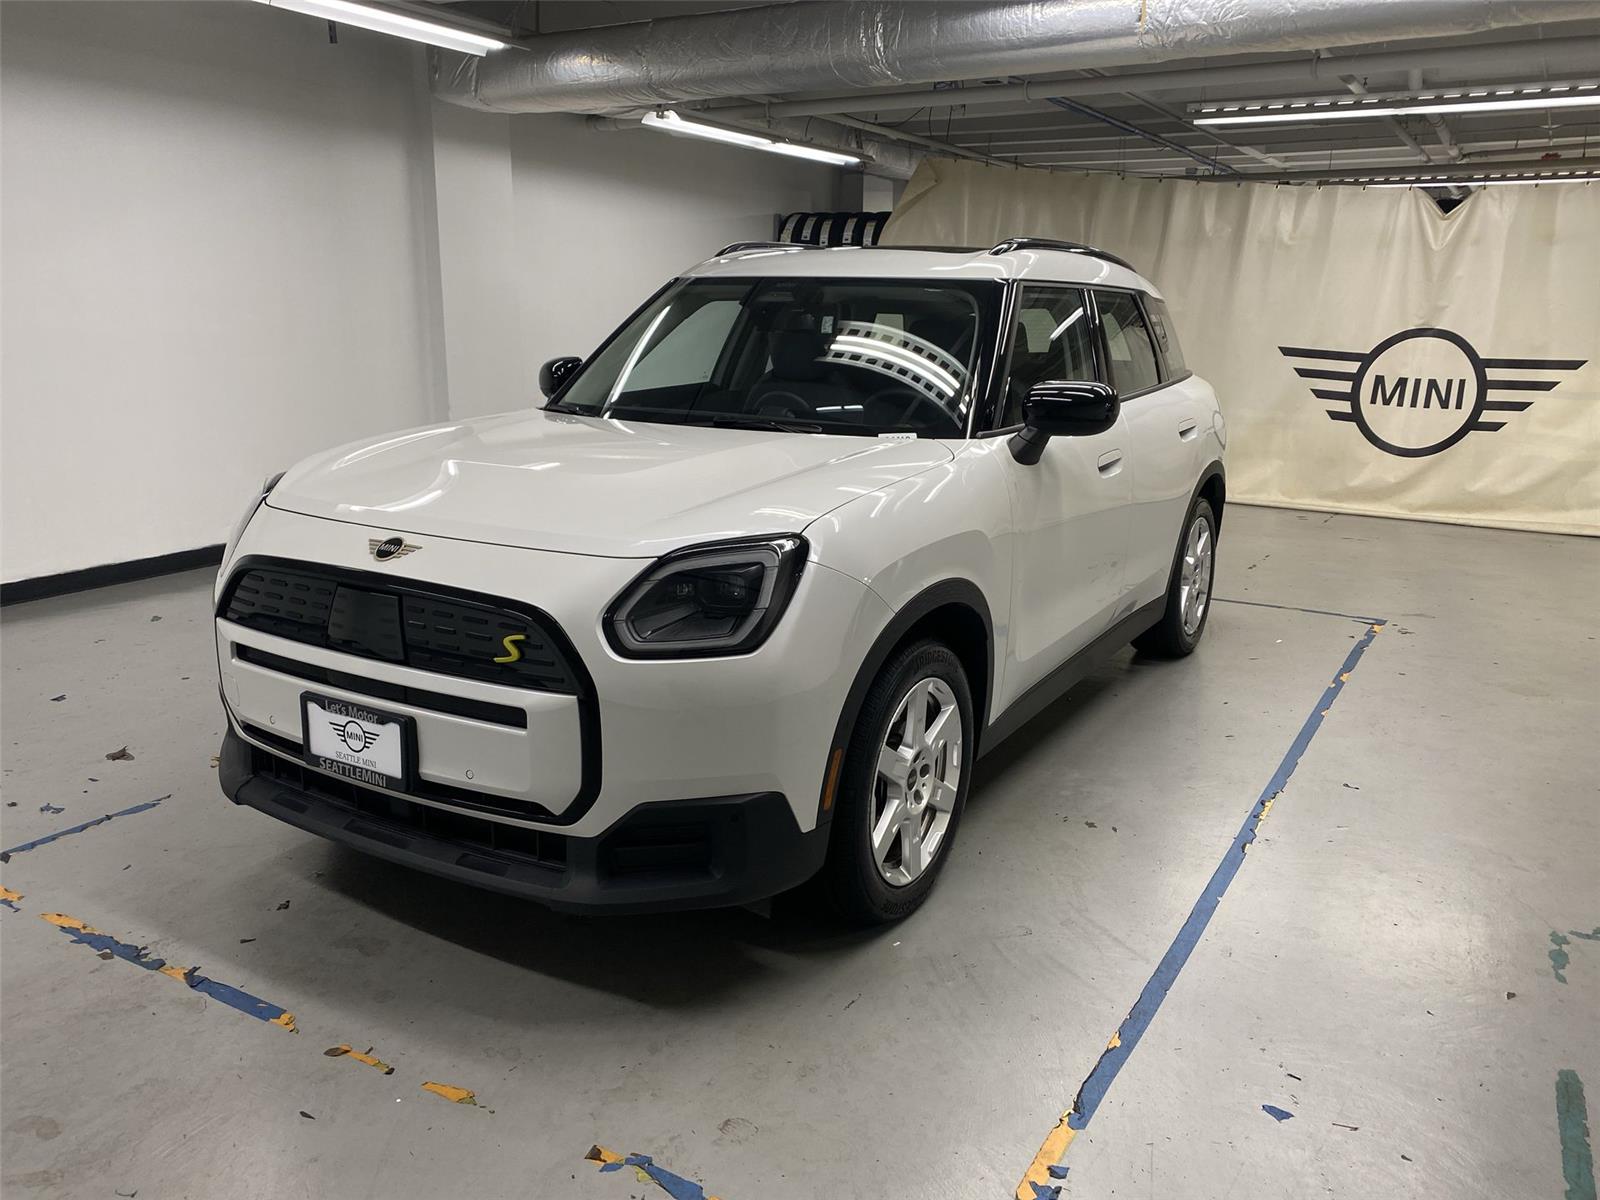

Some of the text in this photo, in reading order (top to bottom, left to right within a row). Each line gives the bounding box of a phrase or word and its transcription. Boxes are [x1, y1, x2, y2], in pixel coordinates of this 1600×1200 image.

[1370, 374, 1466, 410] MINI
[379, 543, 400, 554] MINI
[493, 634, 526, 663] S
[325, 699, 379, 724] Let's Motor
[346, 730, 363, 743] MINI
[335, 750, 377, 769] SEATTLE MINI
[319, 757, 387, 788] SEATTLEMINI
